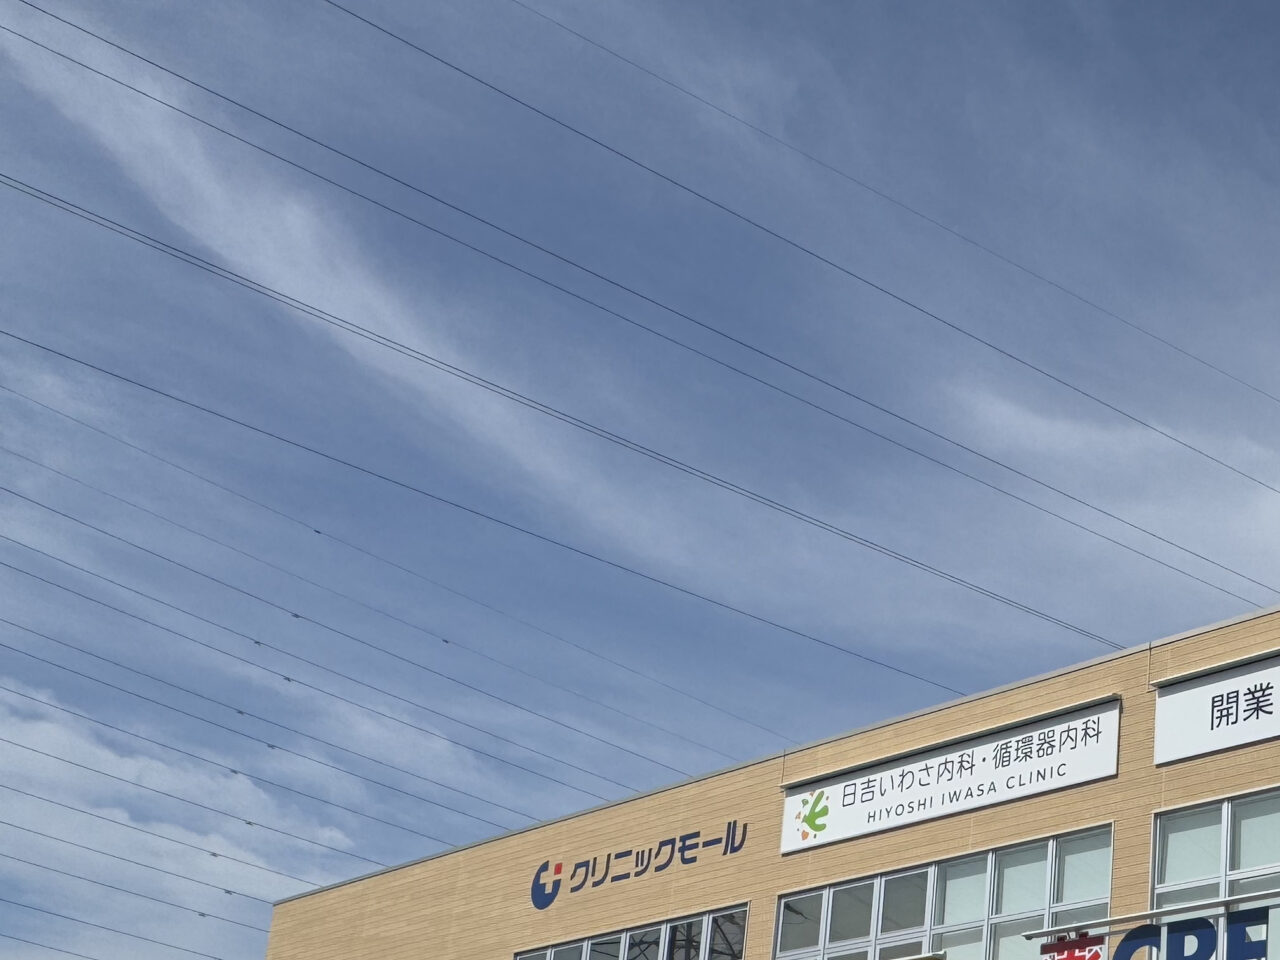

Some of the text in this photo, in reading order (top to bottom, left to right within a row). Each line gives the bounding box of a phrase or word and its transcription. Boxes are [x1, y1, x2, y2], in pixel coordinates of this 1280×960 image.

[841, 716, 1102, 808] 日吉いわさ内科・循環器内科
[867, 763, 1067, 824] HIYOSHI IWASA CLINIC
[570, 819, 748, 894] クリニックモール
